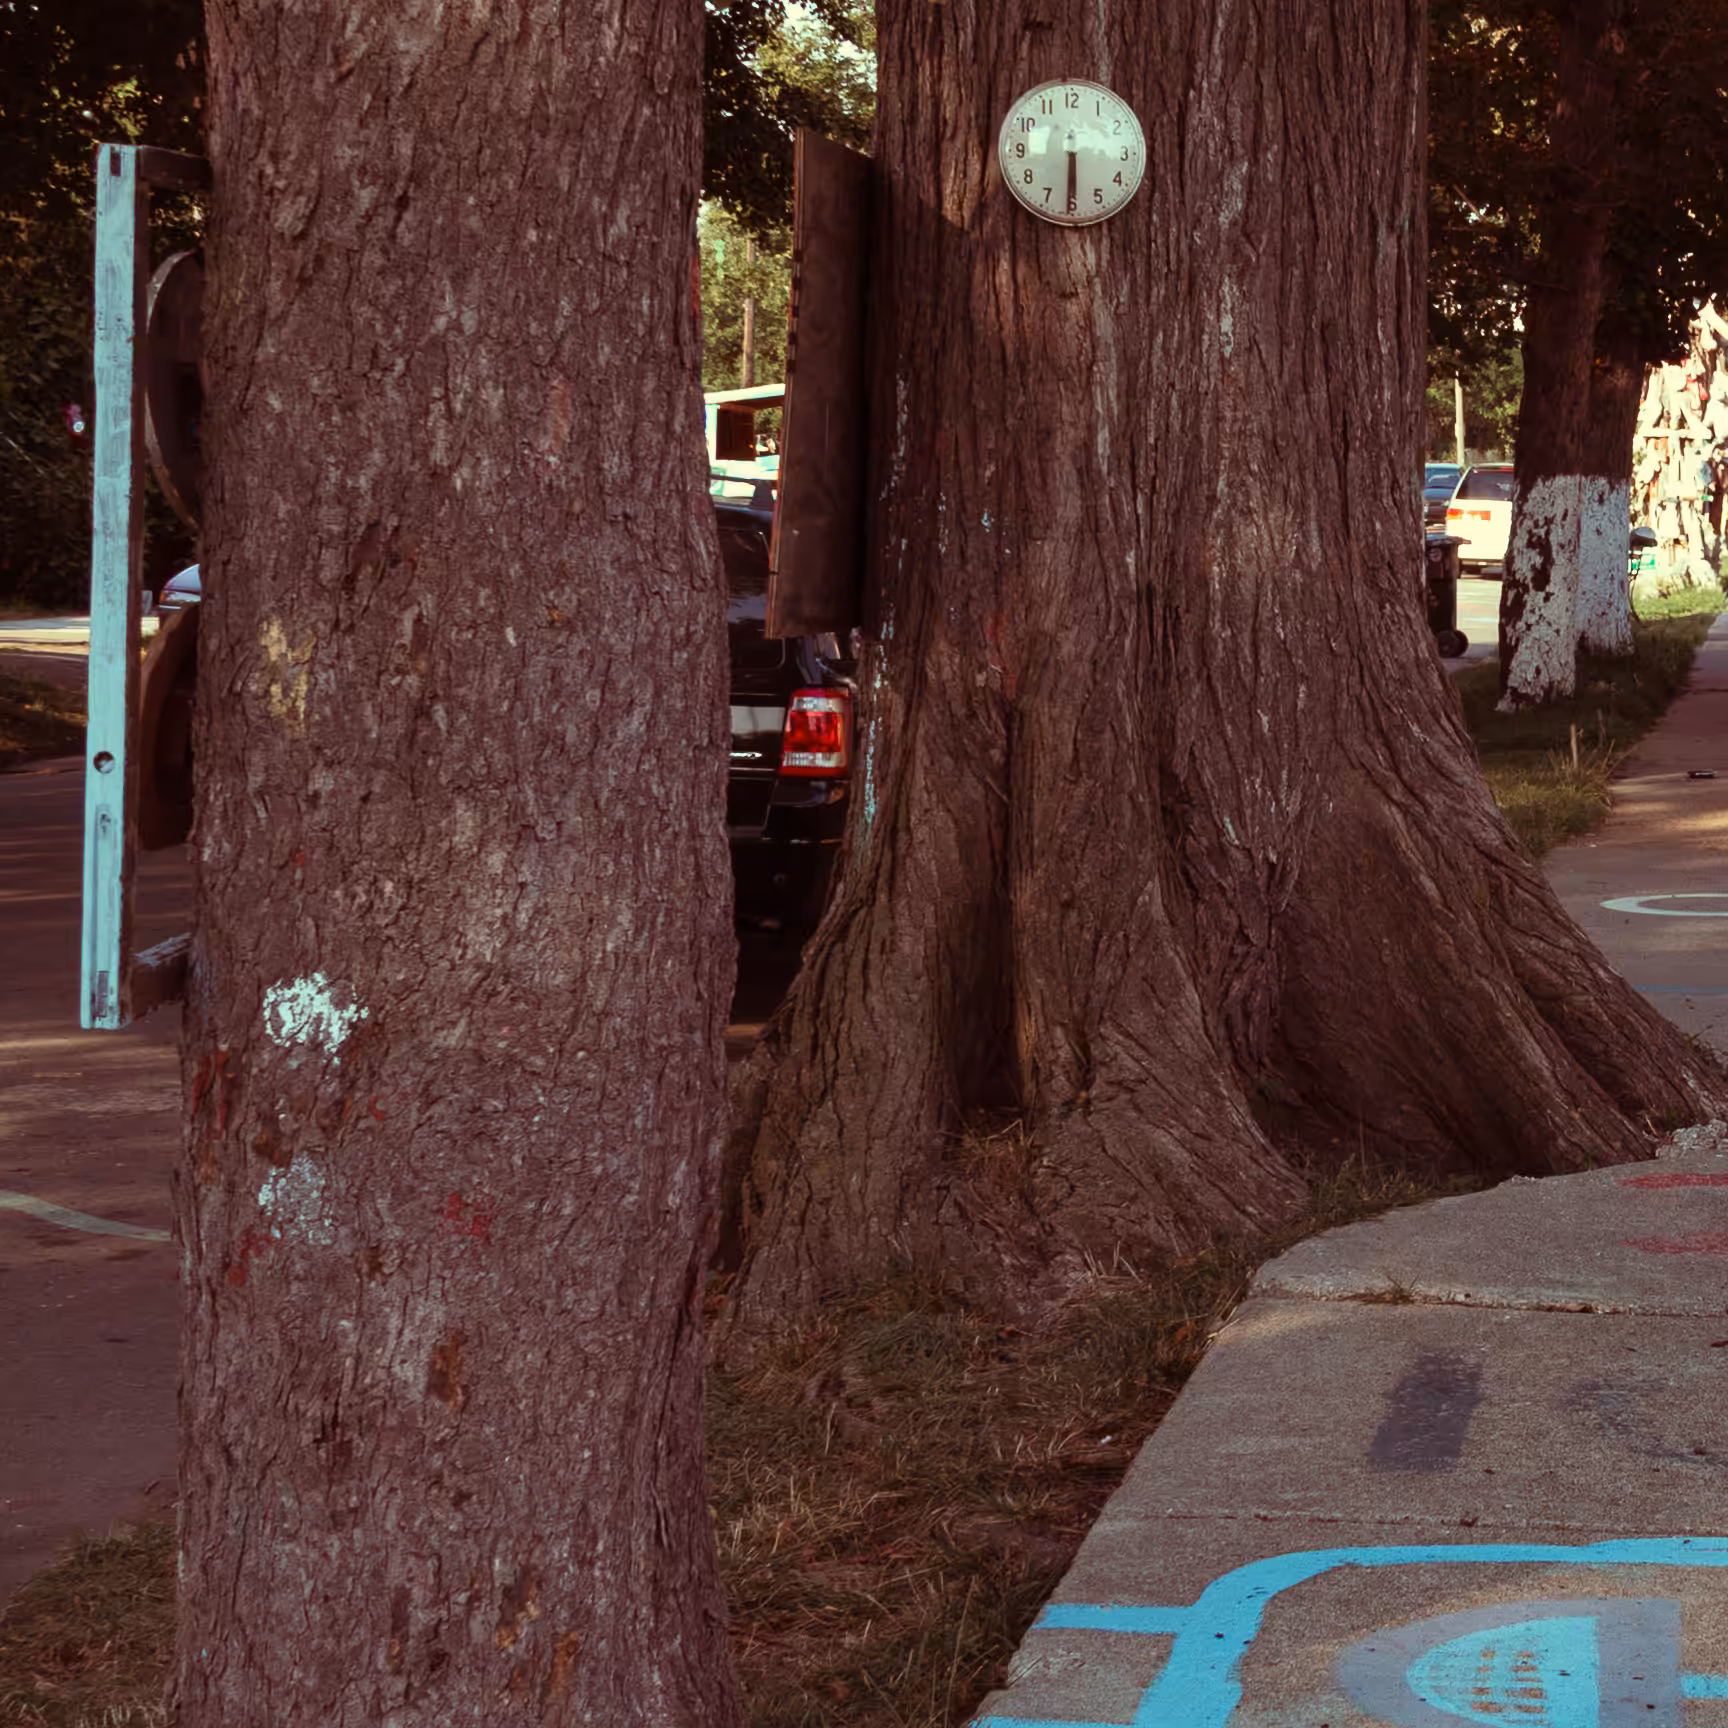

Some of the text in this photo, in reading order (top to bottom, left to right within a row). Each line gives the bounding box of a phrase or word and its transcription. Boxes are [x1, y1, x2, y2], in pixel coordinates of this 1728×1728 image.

[1041, 99, 1053, 115] 11
[1065, 92, 1080, 109] 12
[1020, 117, 1036, 133] 10
[1112, 120, 1122, 136] 2
[1015, 143, 1026, 159] 9
[1119, 146, 1129, 162] 3
[1023, 168, 1034, 185] 8
[1112, 170, 1122, 187] 4
[1042, 187, 1053, 204] 7
[1068, 195, 1078, 212] 6
[1093, 188, 1104, 205] 5
